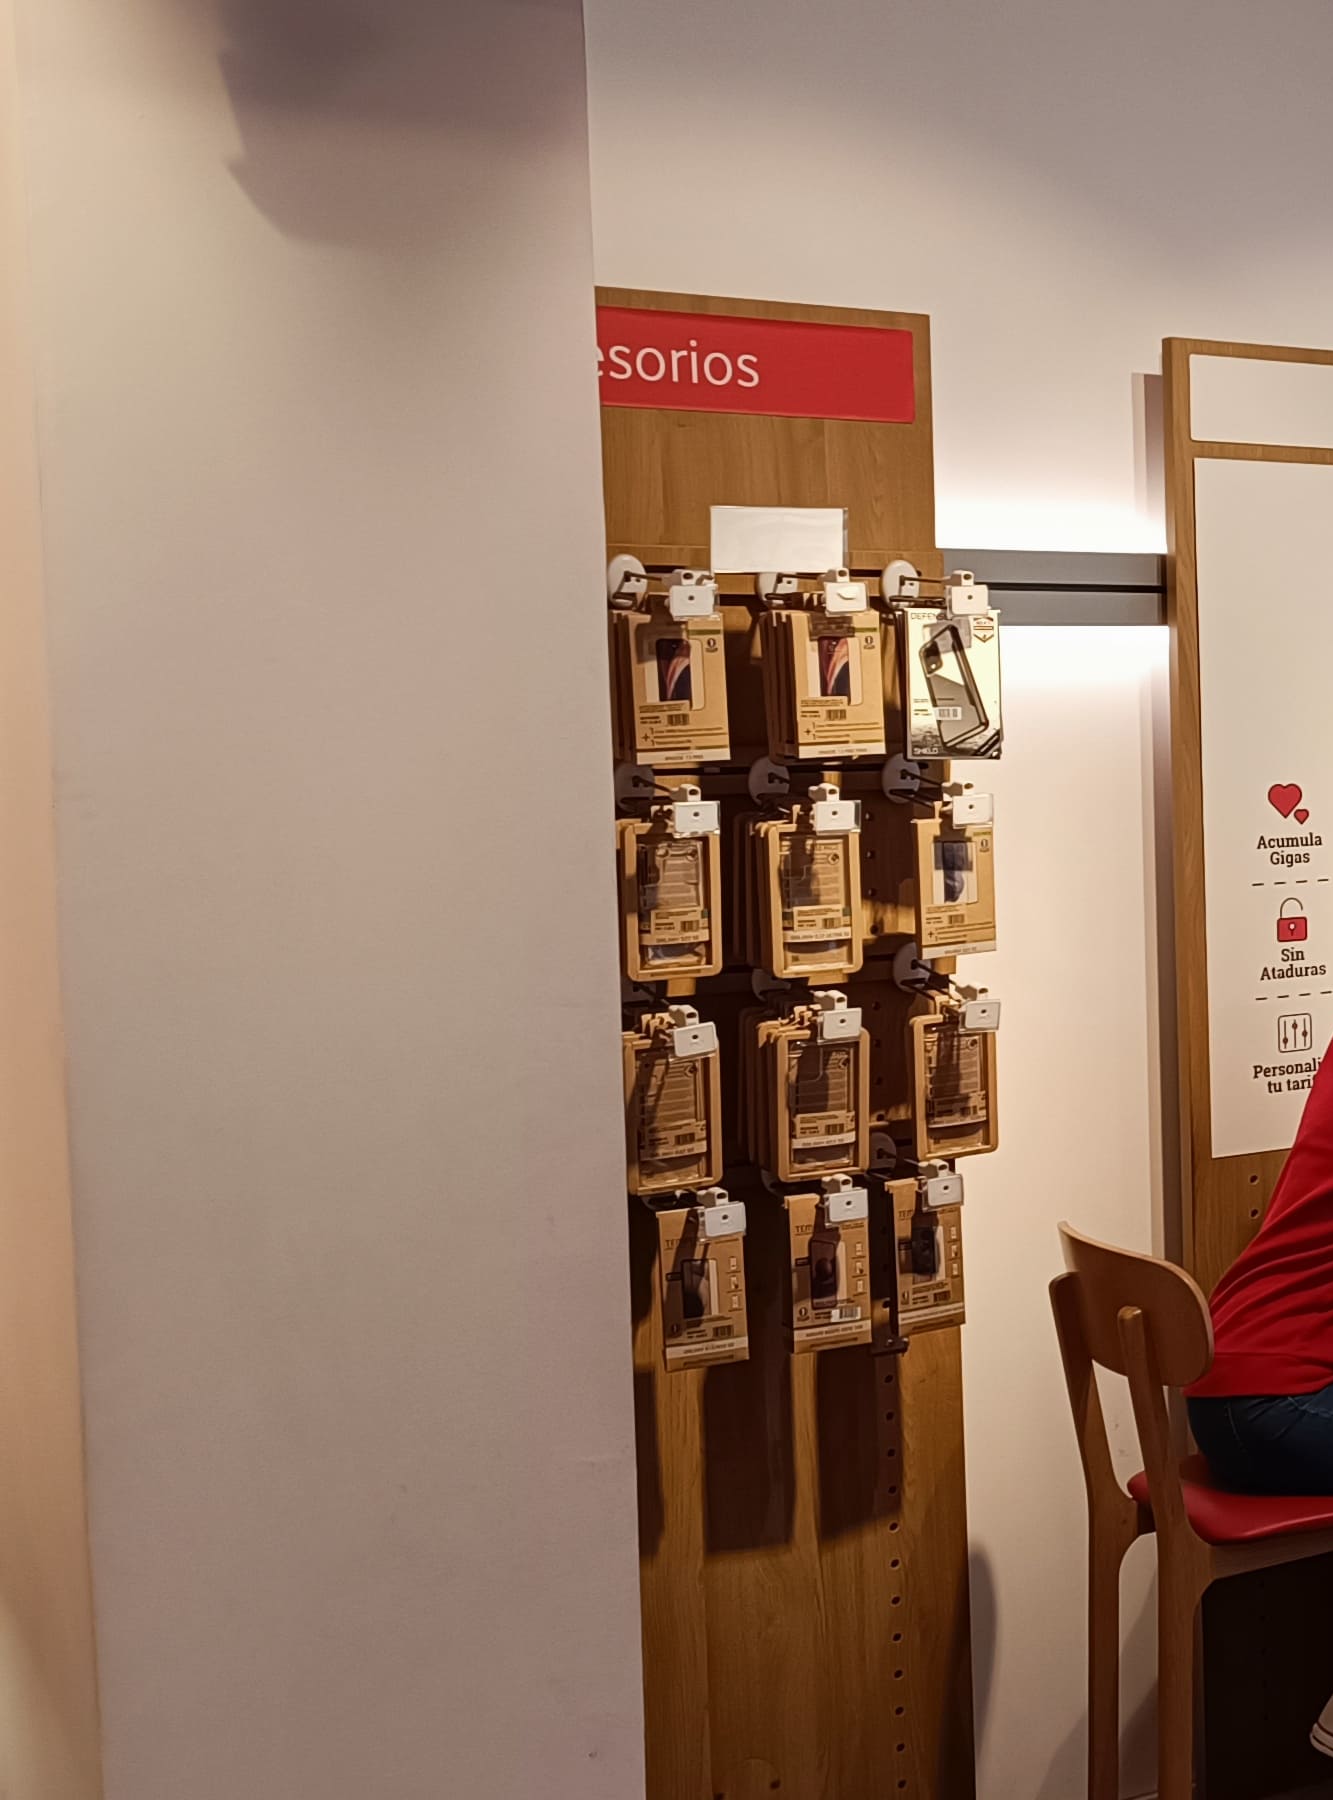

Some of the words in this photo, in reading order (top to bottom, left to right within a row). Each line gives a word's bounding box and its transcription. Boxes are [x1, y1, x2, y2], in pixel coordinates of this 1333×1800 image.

[596, 338, 761, 388] sorios
[1256, 831, 1323, 850] Acumula
[1270, 848, 1311, 868] Gigas
[1280, 946, 1305, 962] Sin
[1259, 960, 1327, 980] Ataduras
[1267, 1080, 1283, 1094] tu
[1287, 1074, 1314, 1091] tari
